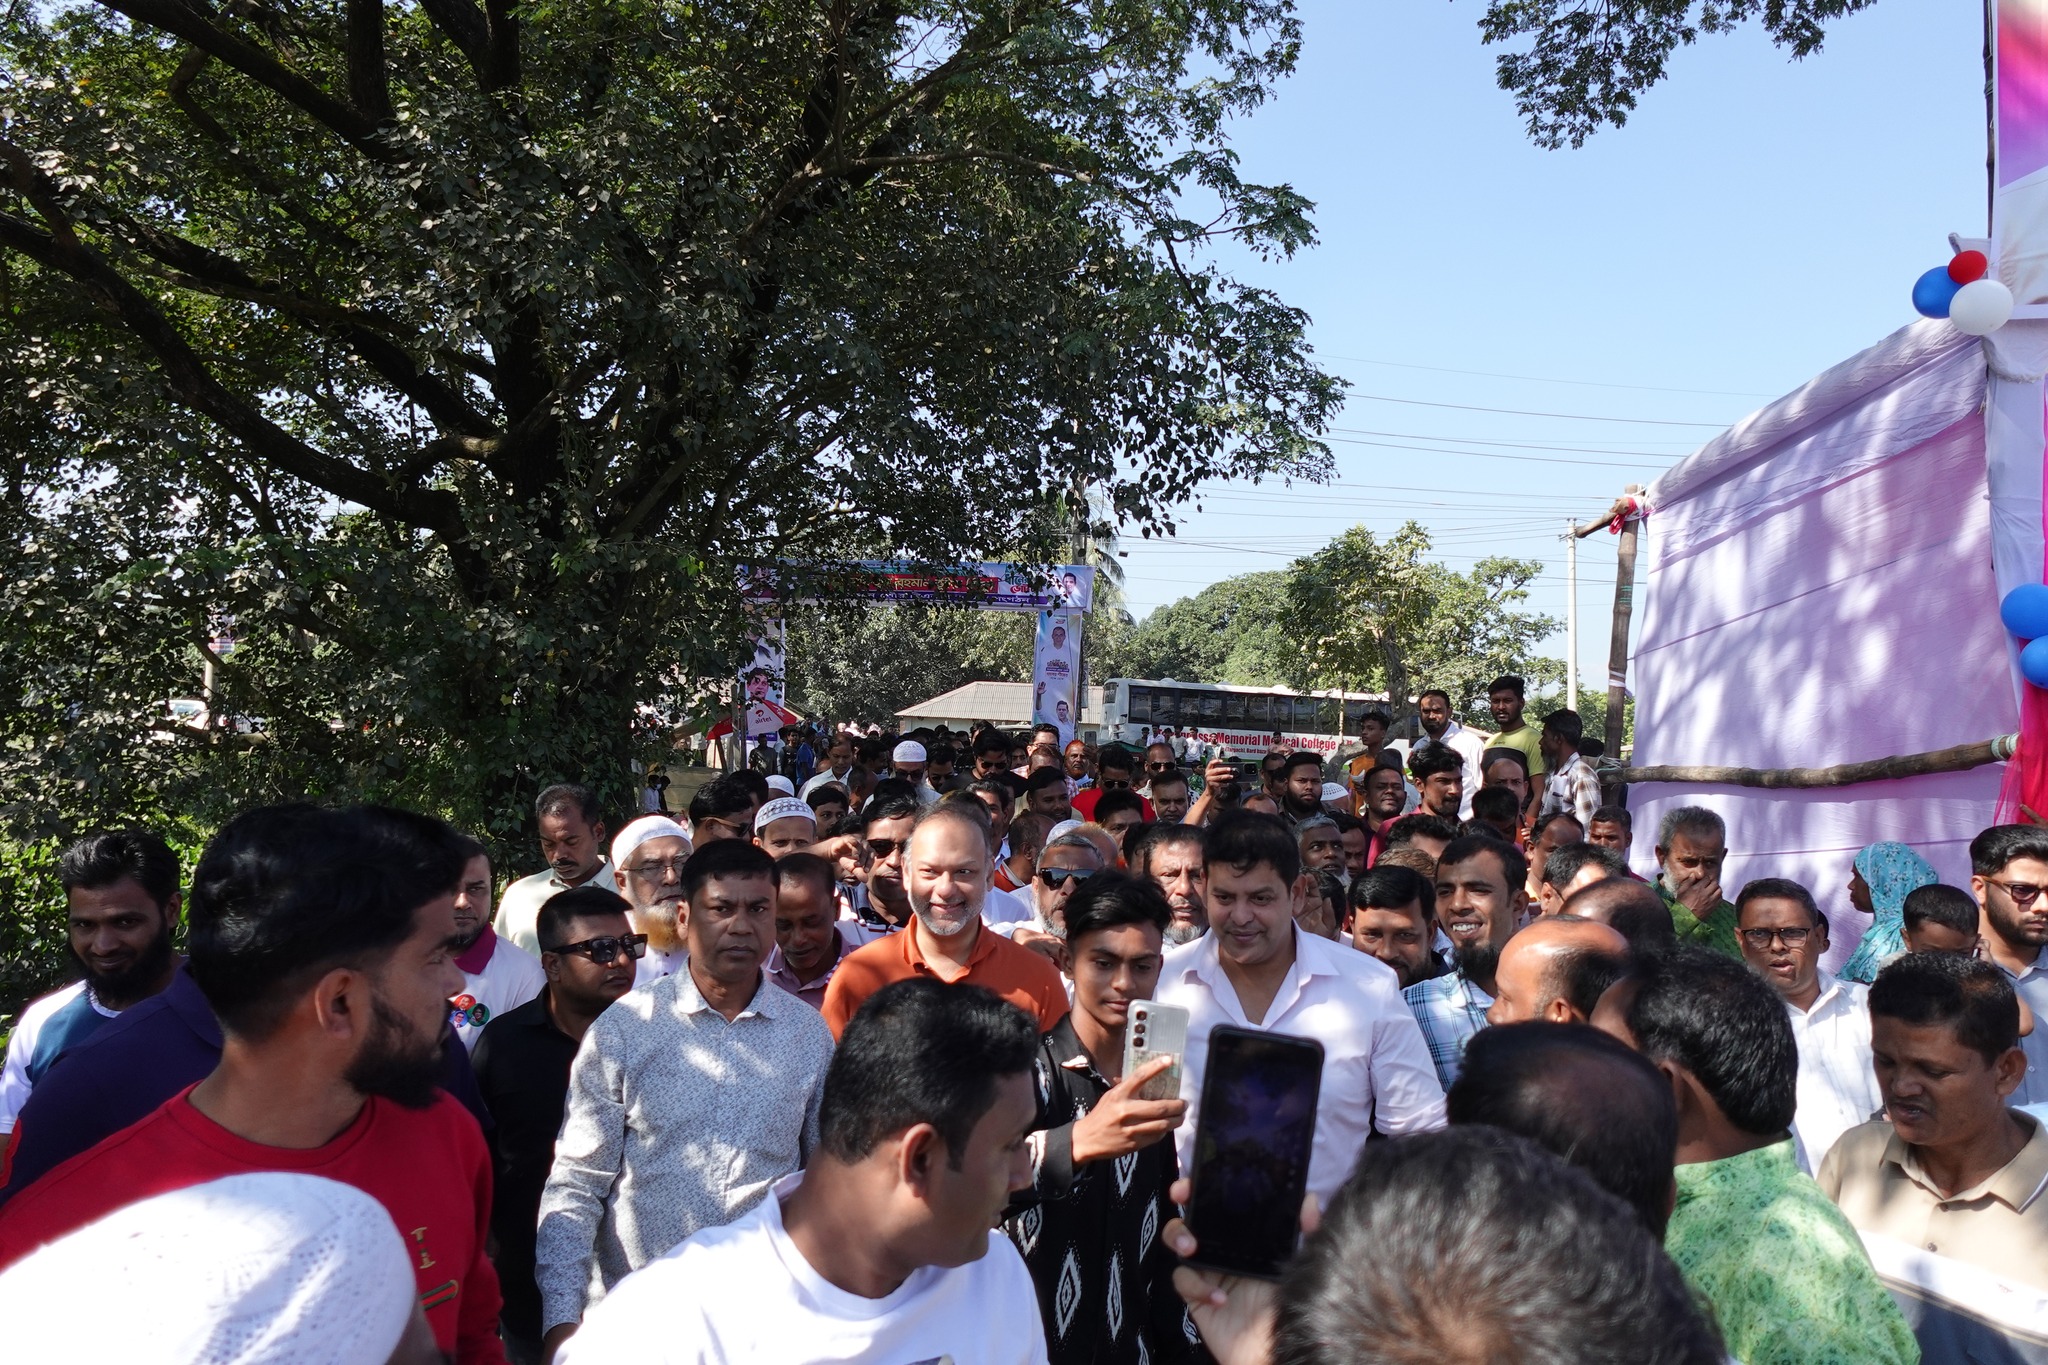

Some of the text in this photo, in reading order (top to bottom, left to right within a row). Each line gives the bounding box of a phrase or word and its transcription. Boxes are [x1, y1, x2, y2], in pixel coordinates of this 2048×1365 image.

[755, 716, 773, 724] airtel
[1217, 732, 1260, 746] Memorial
[1301, 737, 1336, 751] College
